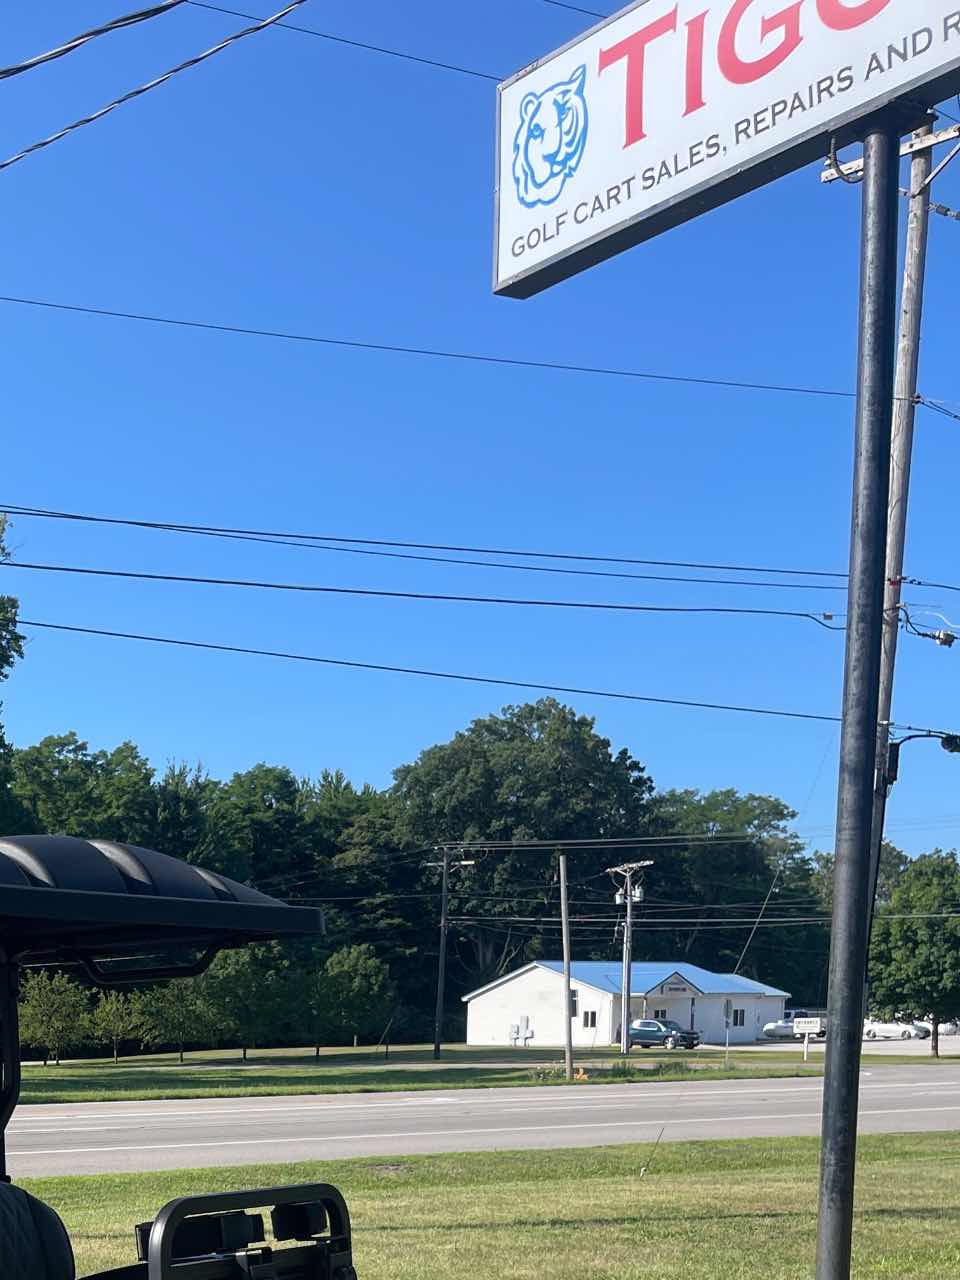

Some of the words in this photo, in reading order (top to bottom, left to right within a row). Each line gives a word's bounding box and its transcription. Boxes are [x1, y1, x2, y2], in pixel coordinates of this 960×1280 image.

[511, 212, 569, 258] GOLF
[573, 175, 637, 225] CART
[641, 133, 728, 191] SALES,
[734, 65, 854, 145] REPAIRS
[863, 27, 933, 82] AND
